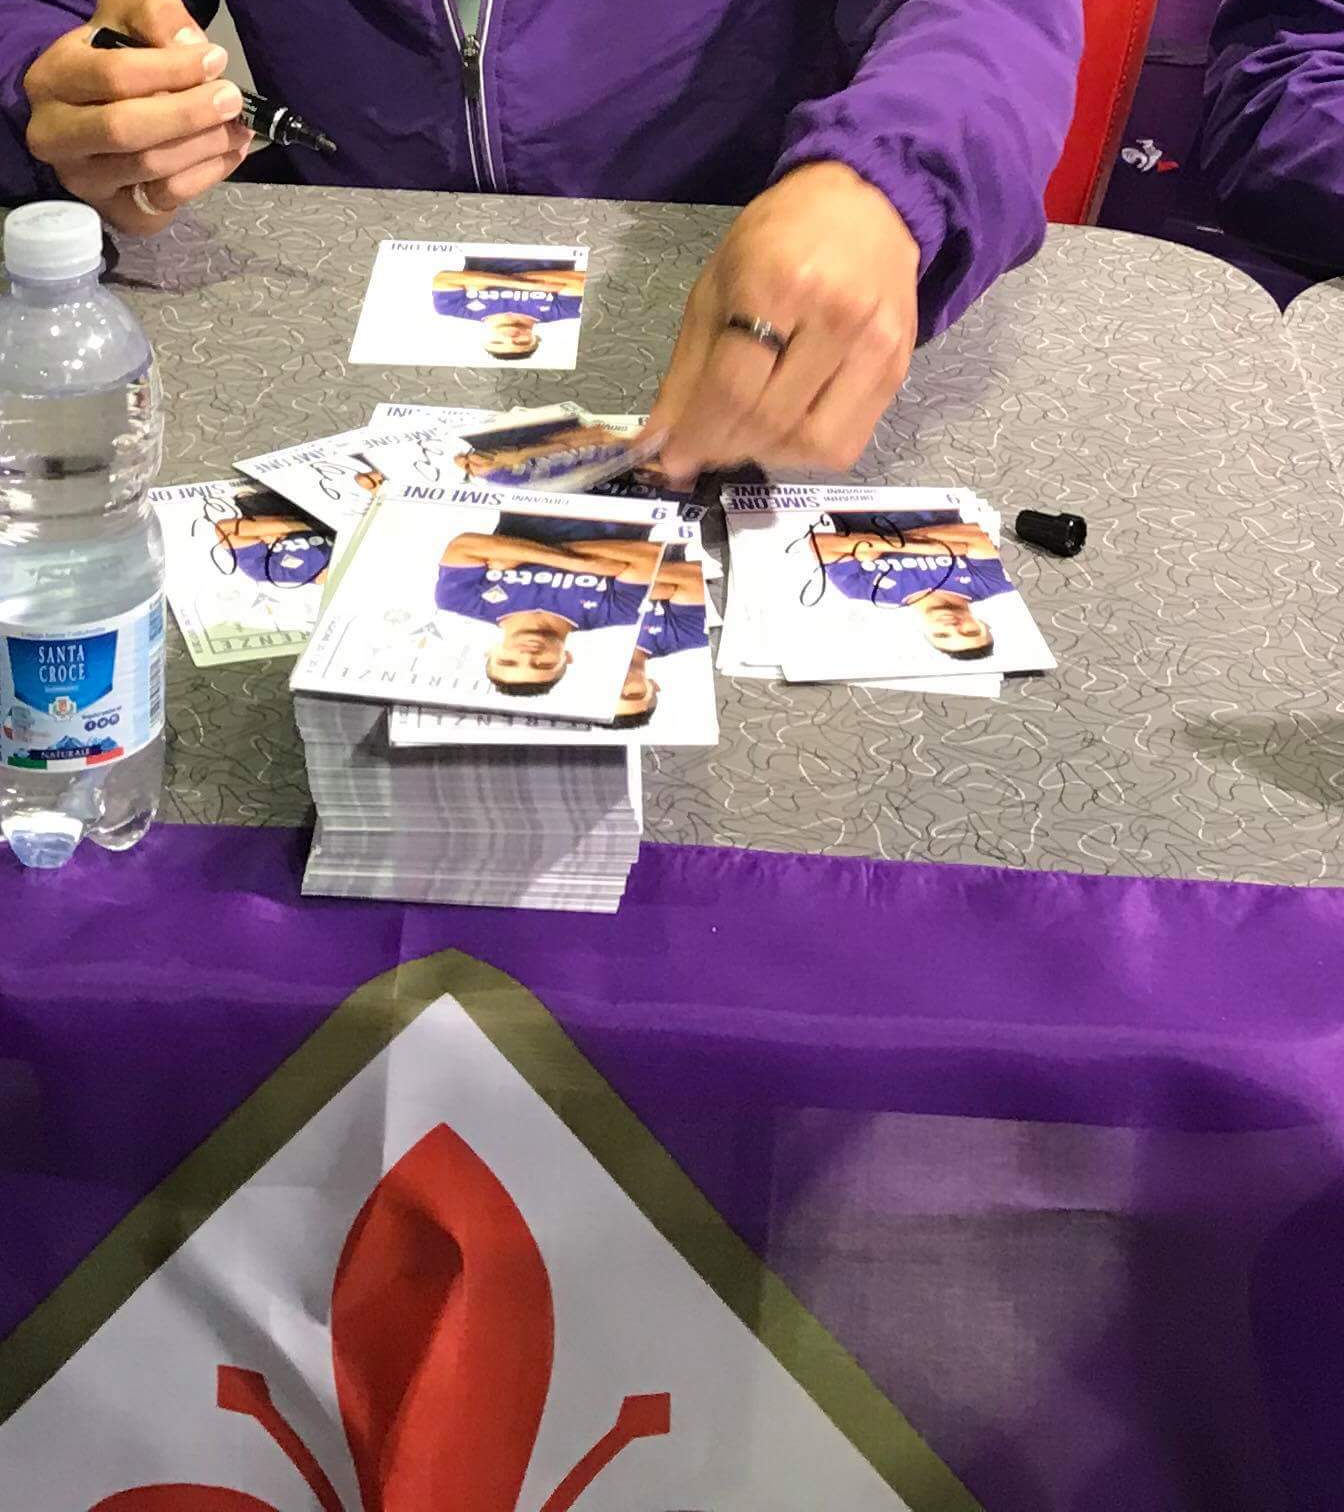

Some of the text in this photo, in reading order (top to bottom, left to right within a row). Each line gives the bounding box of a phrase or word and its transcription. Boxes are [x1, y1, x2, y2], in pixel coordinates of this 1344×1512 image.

[651, 508, 668, 522] 9
[485, 568, 608, 591] folletto
[219, 630, 311, 652] RENZE
[38, 644, 86, 664] SANTA
[38, 663, 86, 683] CROCE
